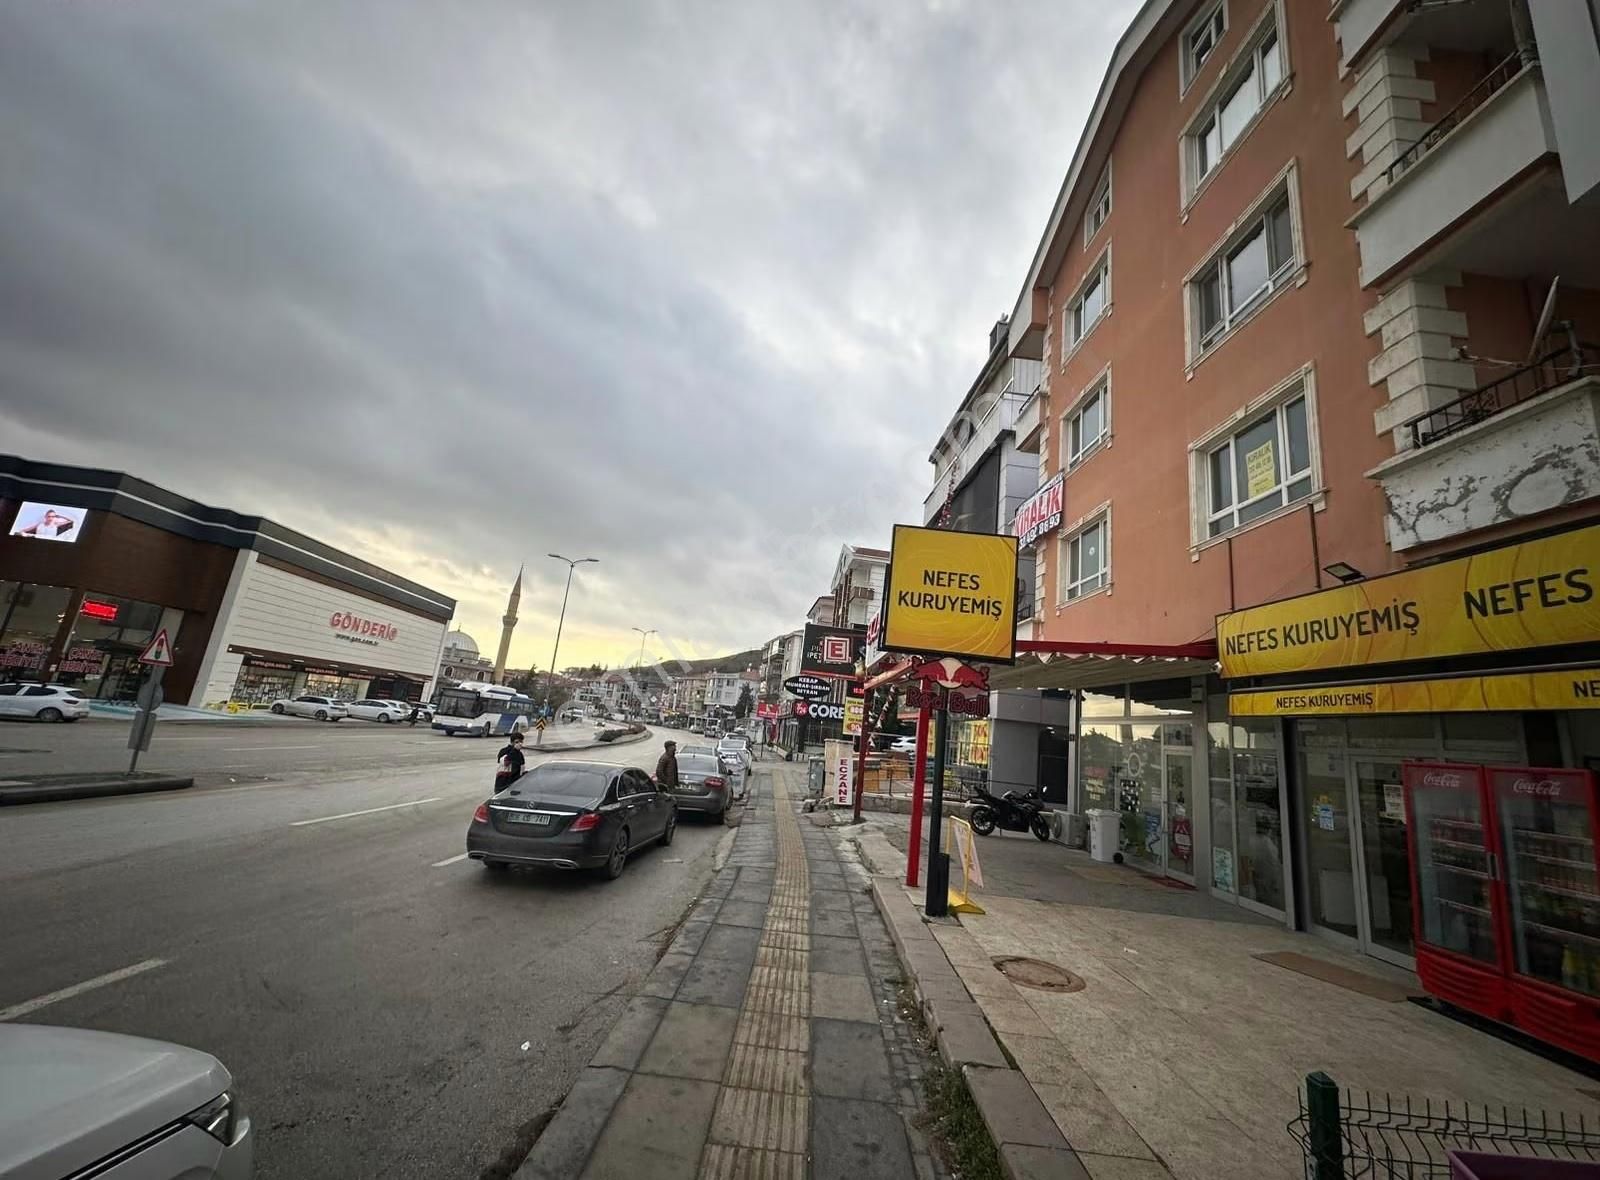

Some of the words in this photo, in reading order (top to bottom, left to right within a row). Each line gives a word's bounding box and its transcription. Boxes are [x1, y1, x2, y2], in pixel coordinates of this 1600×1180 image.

[923, 569, 980, 591] NEFES
[1464, 568, 1593, 620] NEFES
[898, 590, 1002, 621] KURUYEMİŞ
[330, 611, 361, 632] GÖN
[361, 620, 391, 639] DERİ
[1226, 627, 1278, 656] NEFES
[1283, 598, 1420, 648] KURUYEMİŞ
[798, 676, 818, 684] KEBAP
[906, 686, 946, 711] Red
[949, 691, 989, 716] Bull
[1276, 695, 1306, 708] NEFES
[1308, 691, 1373, 709] KURUYEMİŞ
[838, 759, 849, 803] ECZANE
